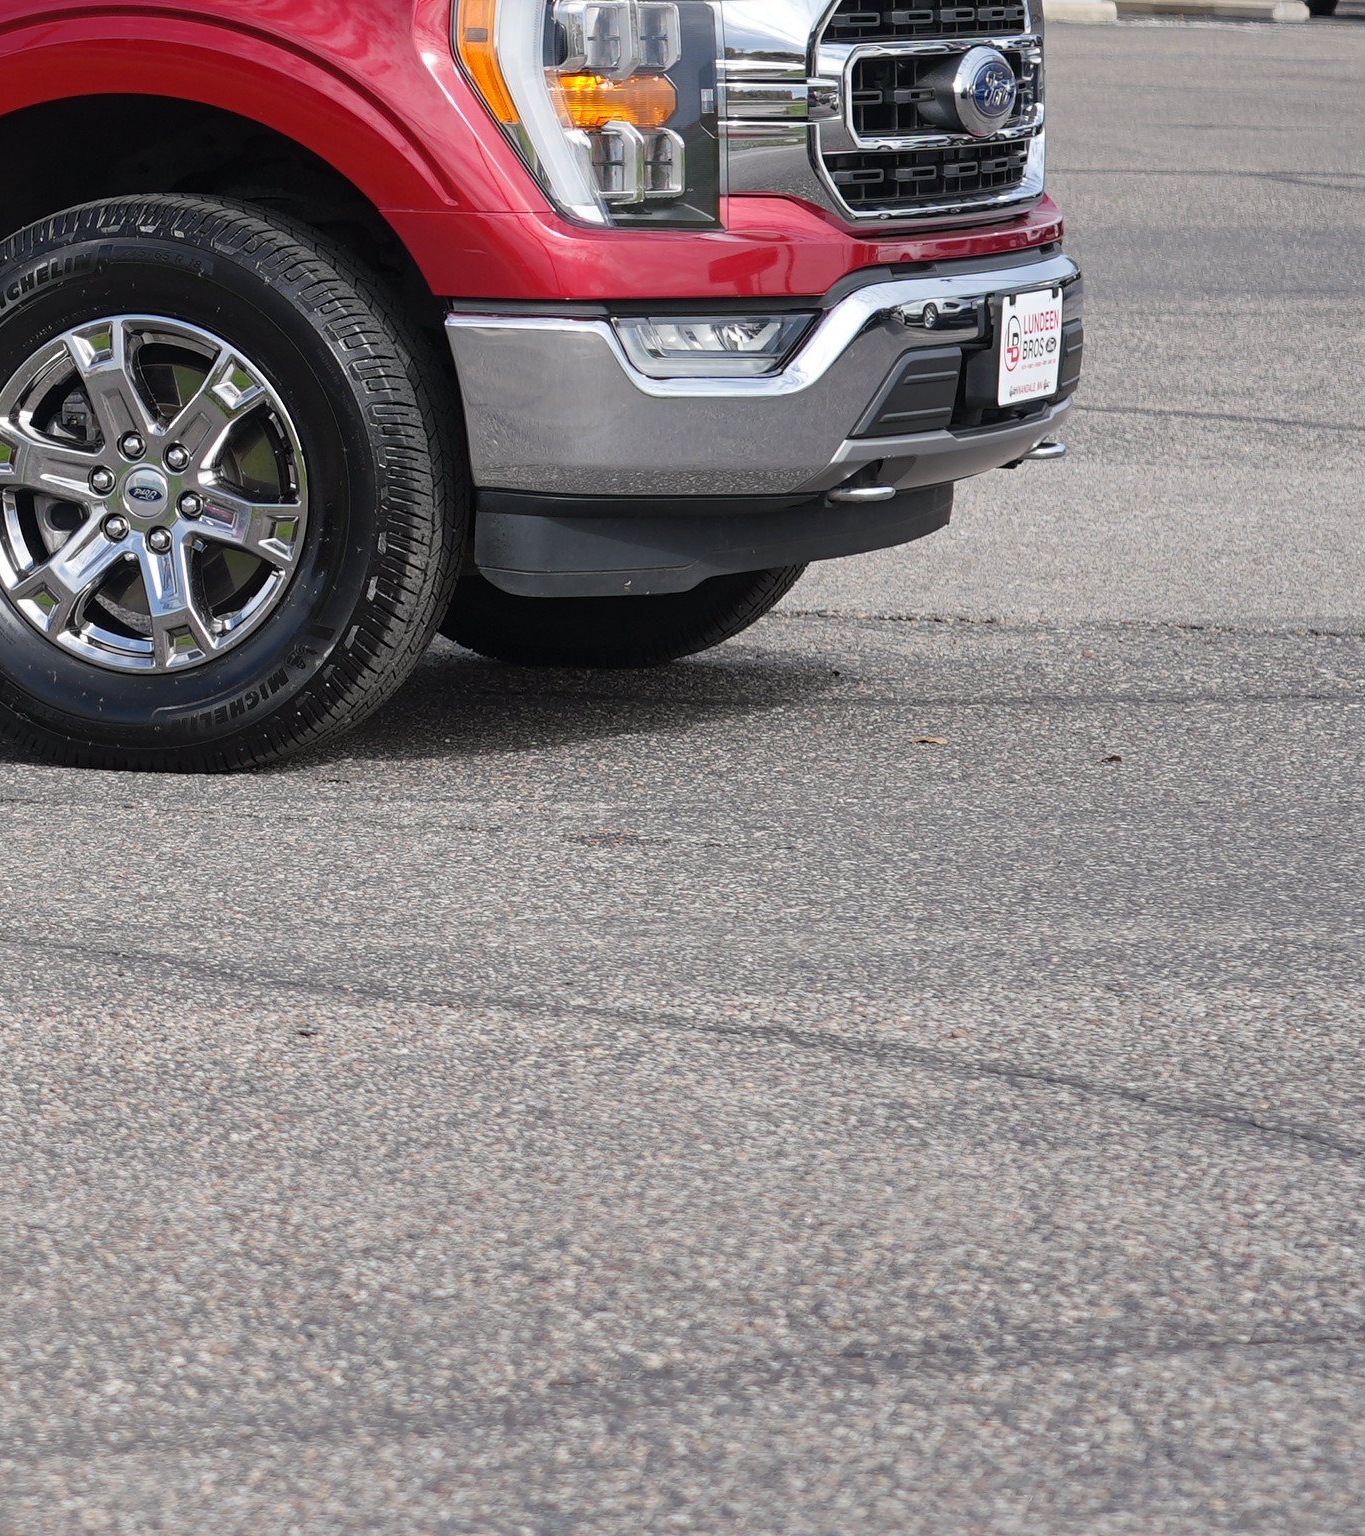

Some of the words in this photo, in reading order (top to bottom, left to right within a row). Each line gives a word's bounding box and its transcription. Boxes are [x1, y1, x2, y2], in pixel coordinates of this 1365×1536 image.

[1023, 310, 1060, 334] LUNDEEN
[1022, 337, 1044, 360] BROS
[170, 667, 290, 731] MICHELIN
